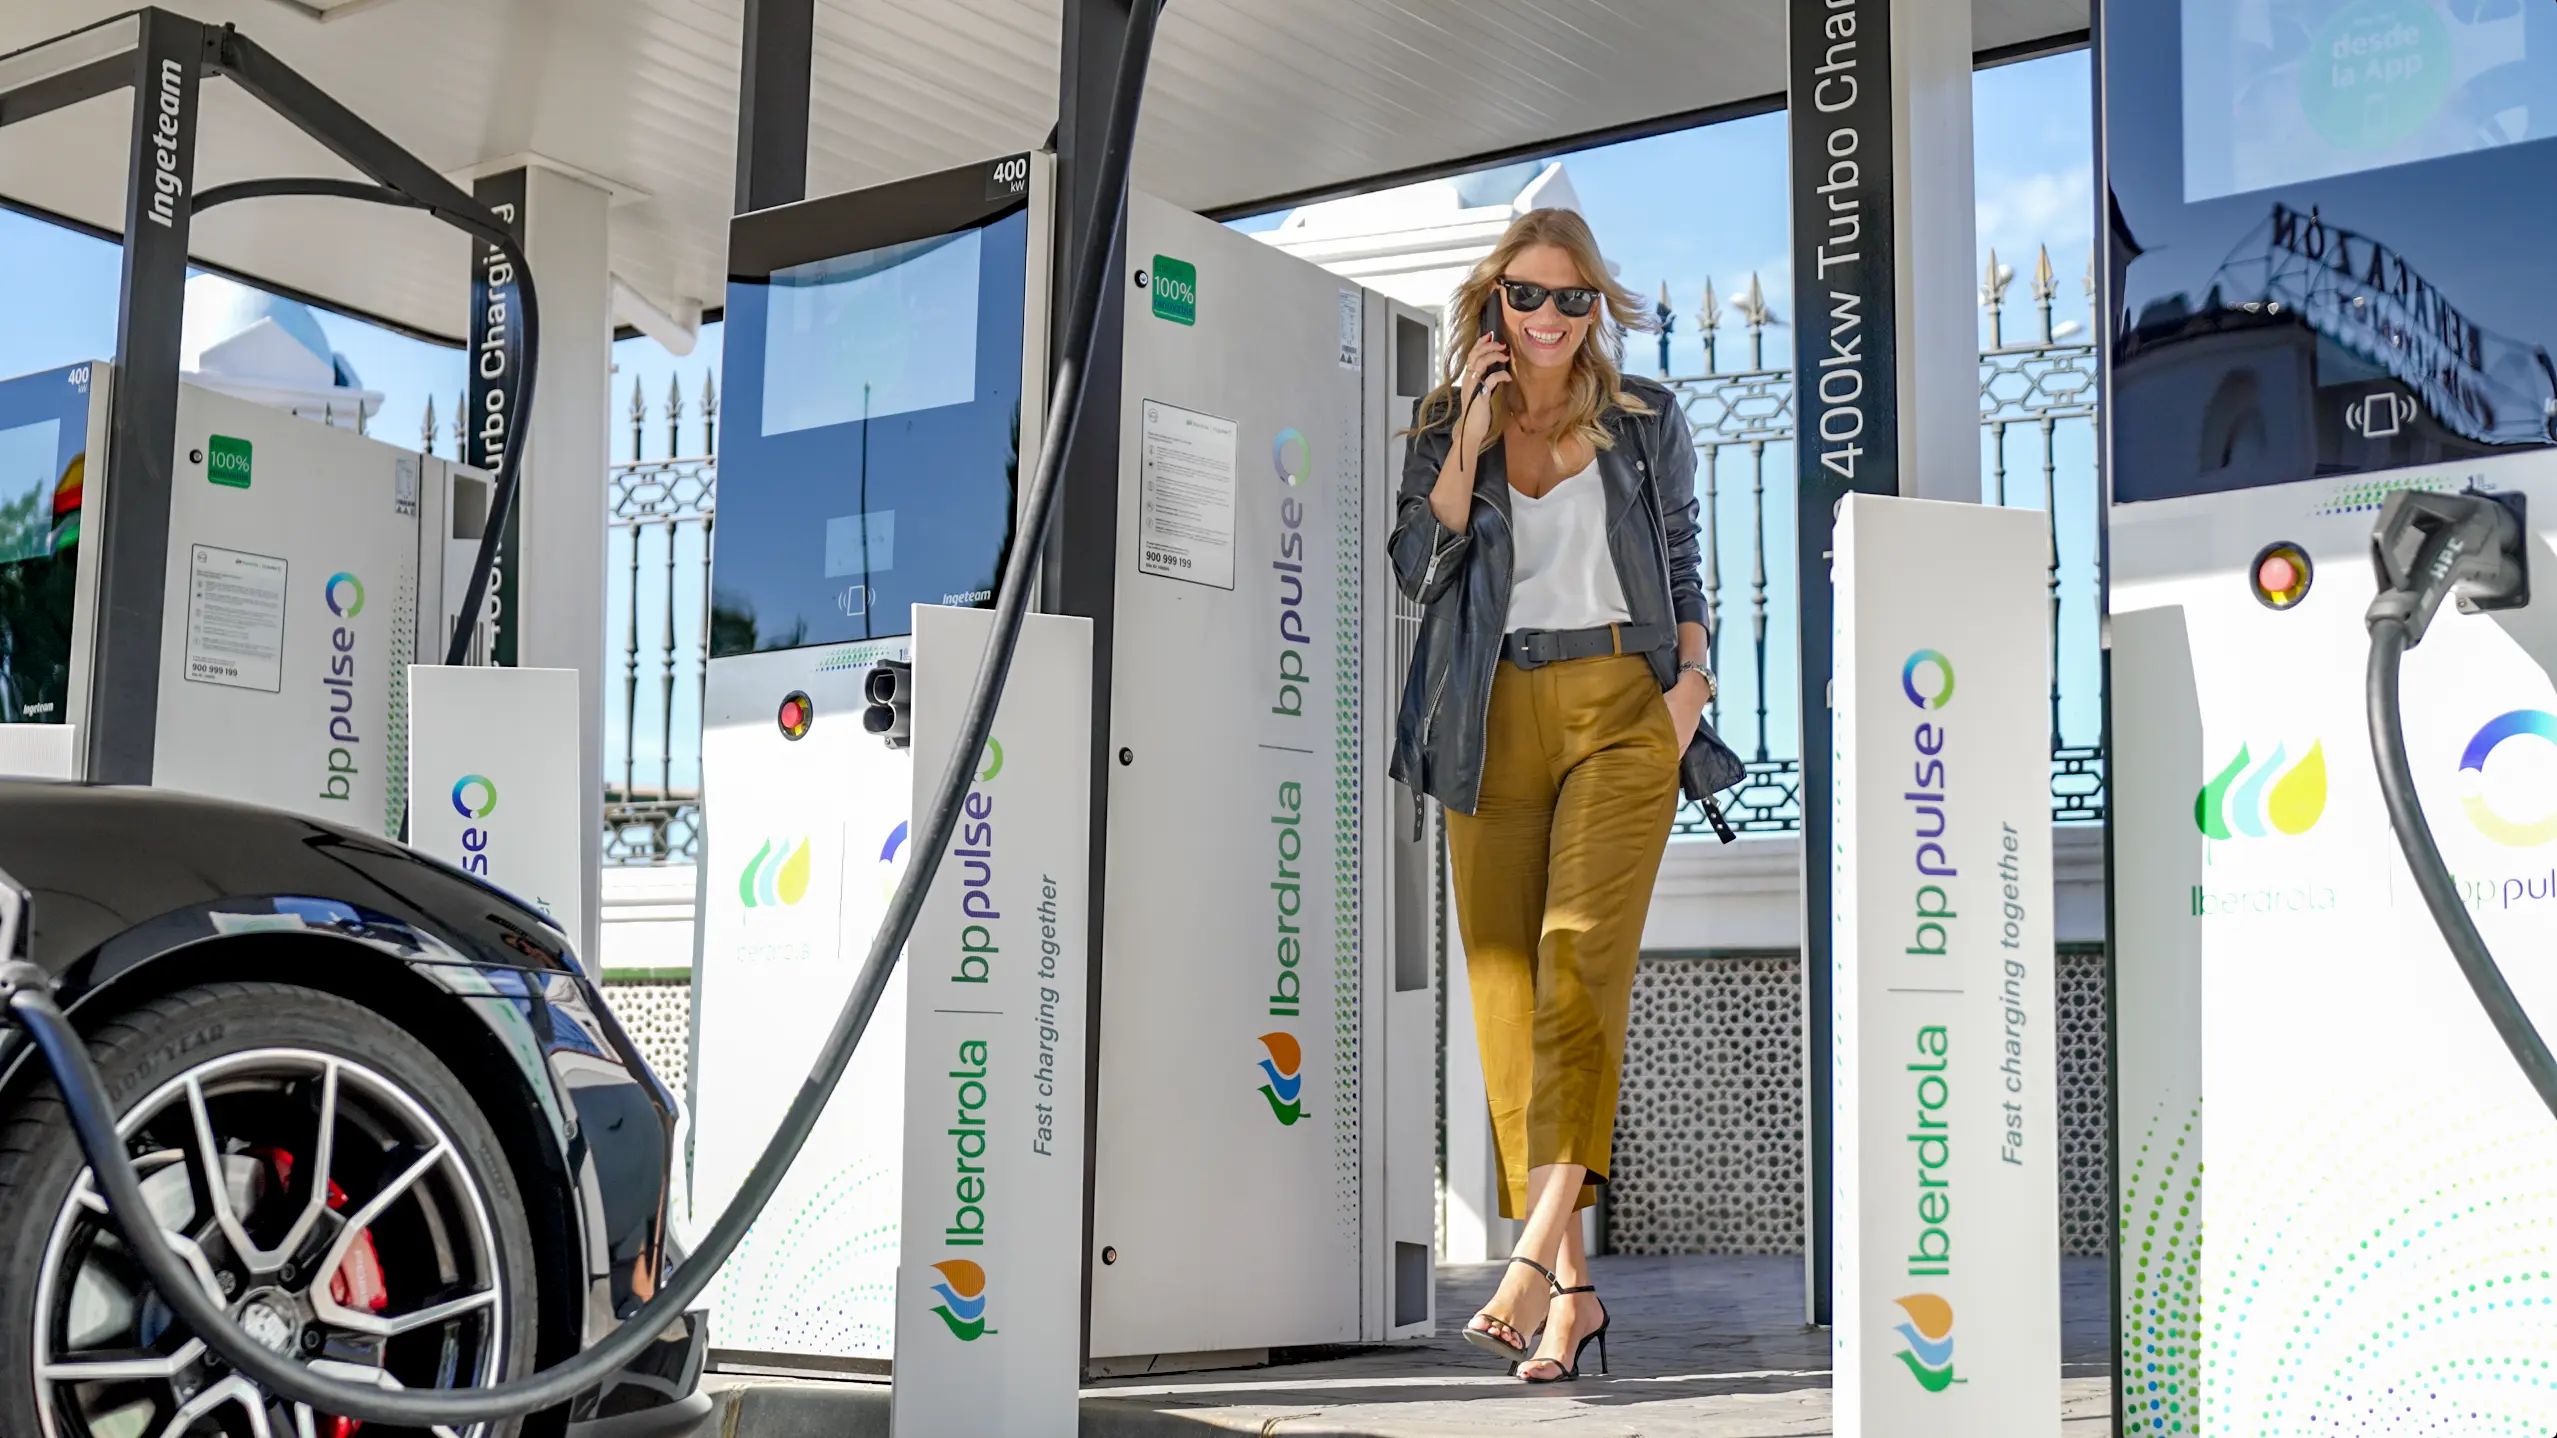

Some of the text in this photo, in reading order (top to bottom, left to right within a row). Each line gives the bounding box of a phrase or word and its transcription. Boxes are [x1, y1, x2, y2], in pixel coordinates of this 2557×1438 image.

[2333, 22, 2420, 59] desde
[2332, 54, 2423, 89] la App
[148, 58, 183, 228] Ingeteam
[993, 158, 1026, 183] 400
[1010, 180, 1026, 192] kW
[1816, 127, 1860, 280] Turbo
[1154, 275, 1194, 304] 100%
[68, 366, 89, 385] 400
[1818, 291, 1864, 479] 400kw
[211, 450, 250, 472] 100%
[1146, 550, 1161, 562] 900
[1163, 554, 1177, 565] 999
[1179, 557, 1192, 568] 199
[2429, 537, 2465, 580] HPC
[942, 590, 991, 607] Ingeteam
[192, 662, 207, 673] 900
[208, 664, 224, 675] 999
[225, 667, 238, 677] 199
[319, 626, 360, 800] bp pulse
[1269, 497, 1311, 1016] Iberdrola bp pulse
[2191, 880, 2336, 916] Iberdrola
[1904, 722, 1957, 1276] Iberdrola bp pulse
[1997, 821, 2026, 1166] Fast charging together
[945, 791, 1001, 1246] Iberdrola bp pulse
[1033, 874, 1061, 1157] Fast charging together
